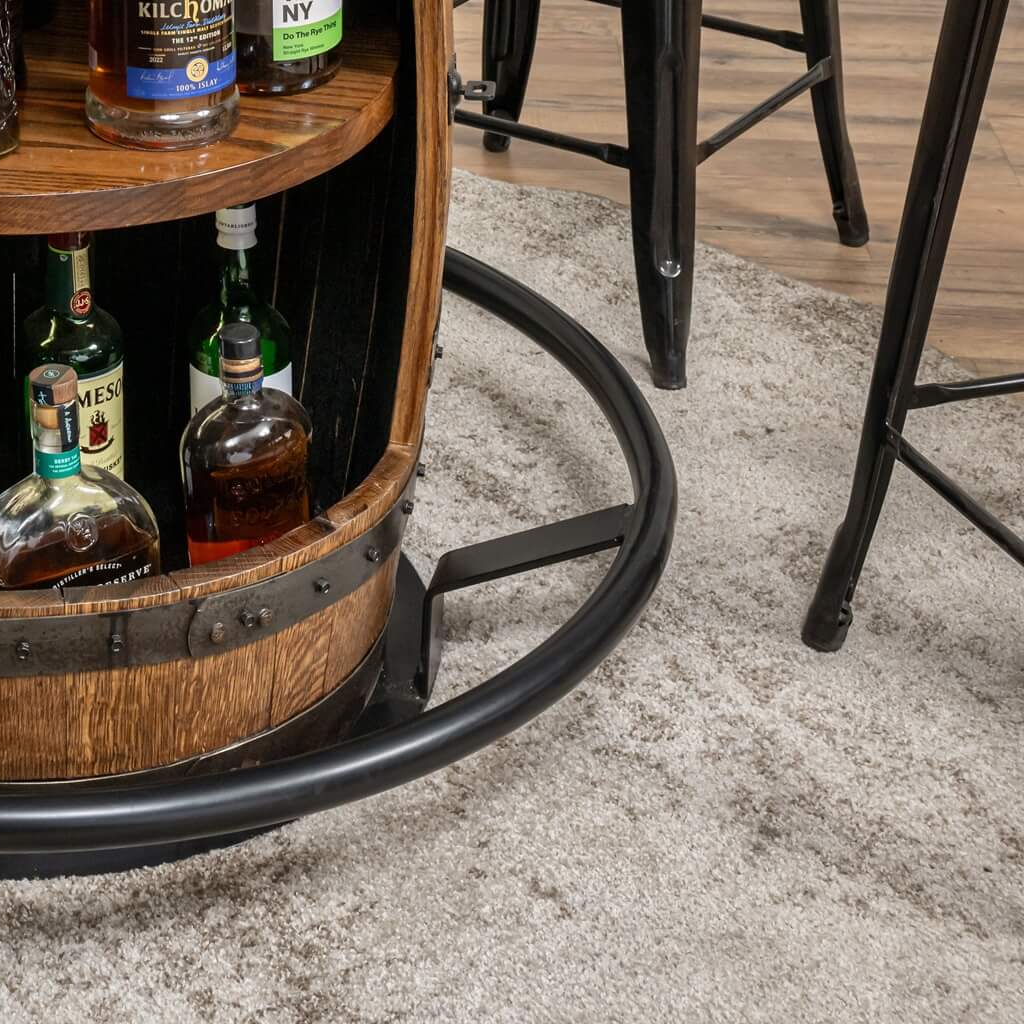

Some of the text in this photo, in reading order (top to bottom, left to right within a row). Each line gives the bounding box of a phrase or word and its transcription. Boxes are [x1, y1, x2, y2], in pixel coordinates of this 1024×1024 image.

[283, 0, 313, 23] NY
[199, 29, 221, 41] EDITION
[283, 20, 337, 41] Do The Rye Thing
[176, 78, 219, 92] 100% ISLAY
